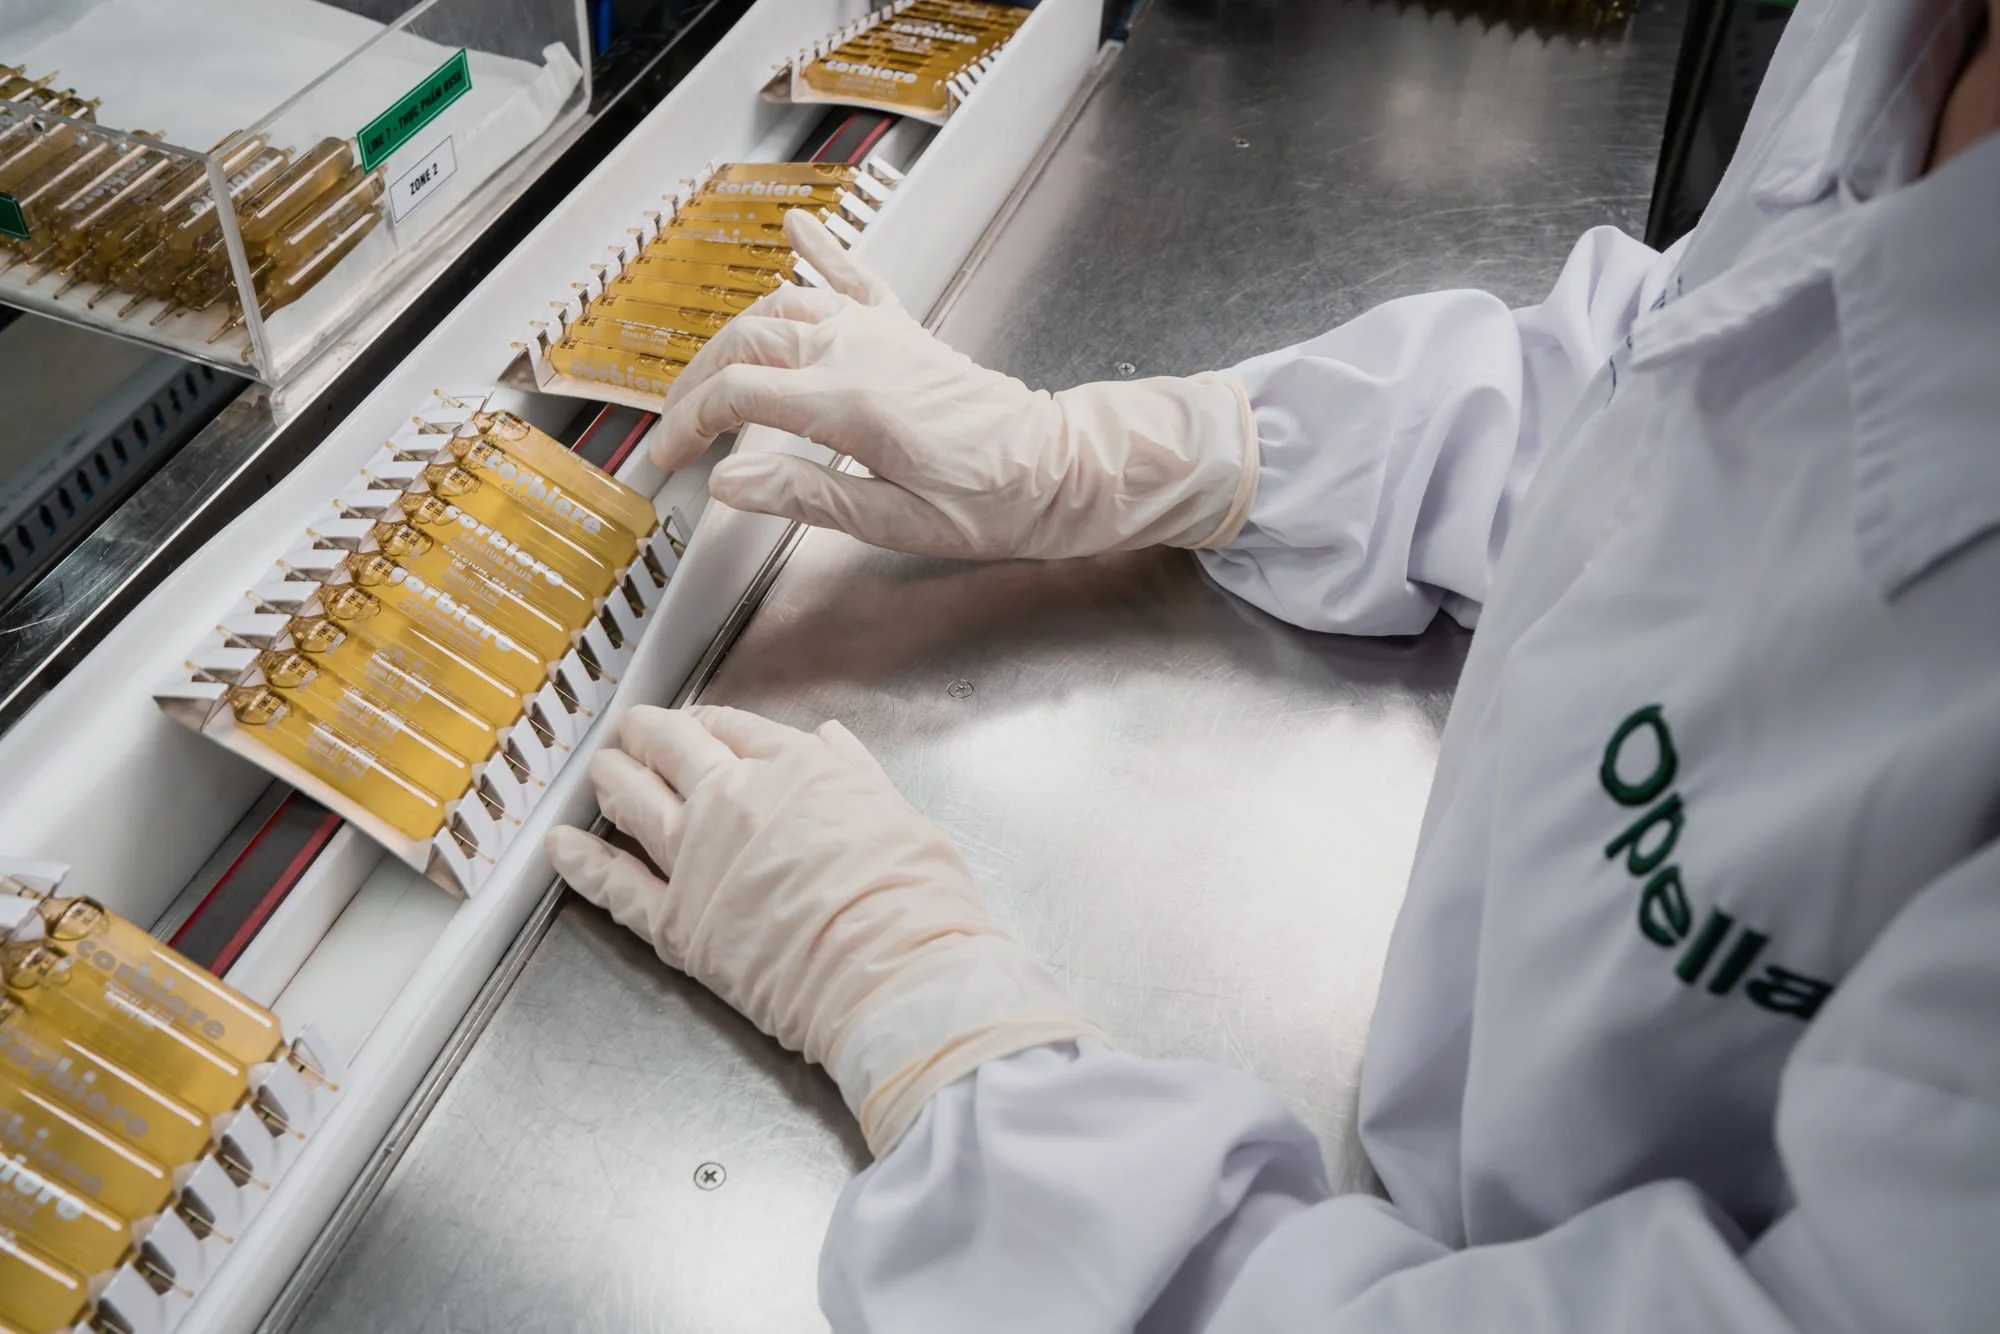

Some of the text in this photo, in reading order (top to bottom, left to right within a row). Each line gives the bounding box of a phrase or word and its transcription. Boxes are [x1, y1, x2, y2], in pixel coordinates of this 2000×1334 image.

[825, 60, 918, 84] corbiere
[366, 132, 385, 156] LINE
[385, 127, 391, 140] 7
[189, 156, 272, 215] corbire
[409, 162, 439, 196] ZONE 2
[716, 181, 813, 197] corbiere
[485, 453, 601, 535] corbiere
[446, 505, 564, 586] corbiere
[391, 566, 515, 652] corbiere
[1599, 703, 1835, 1022] Opella
[77, 939, 226, 1041] corbiere
